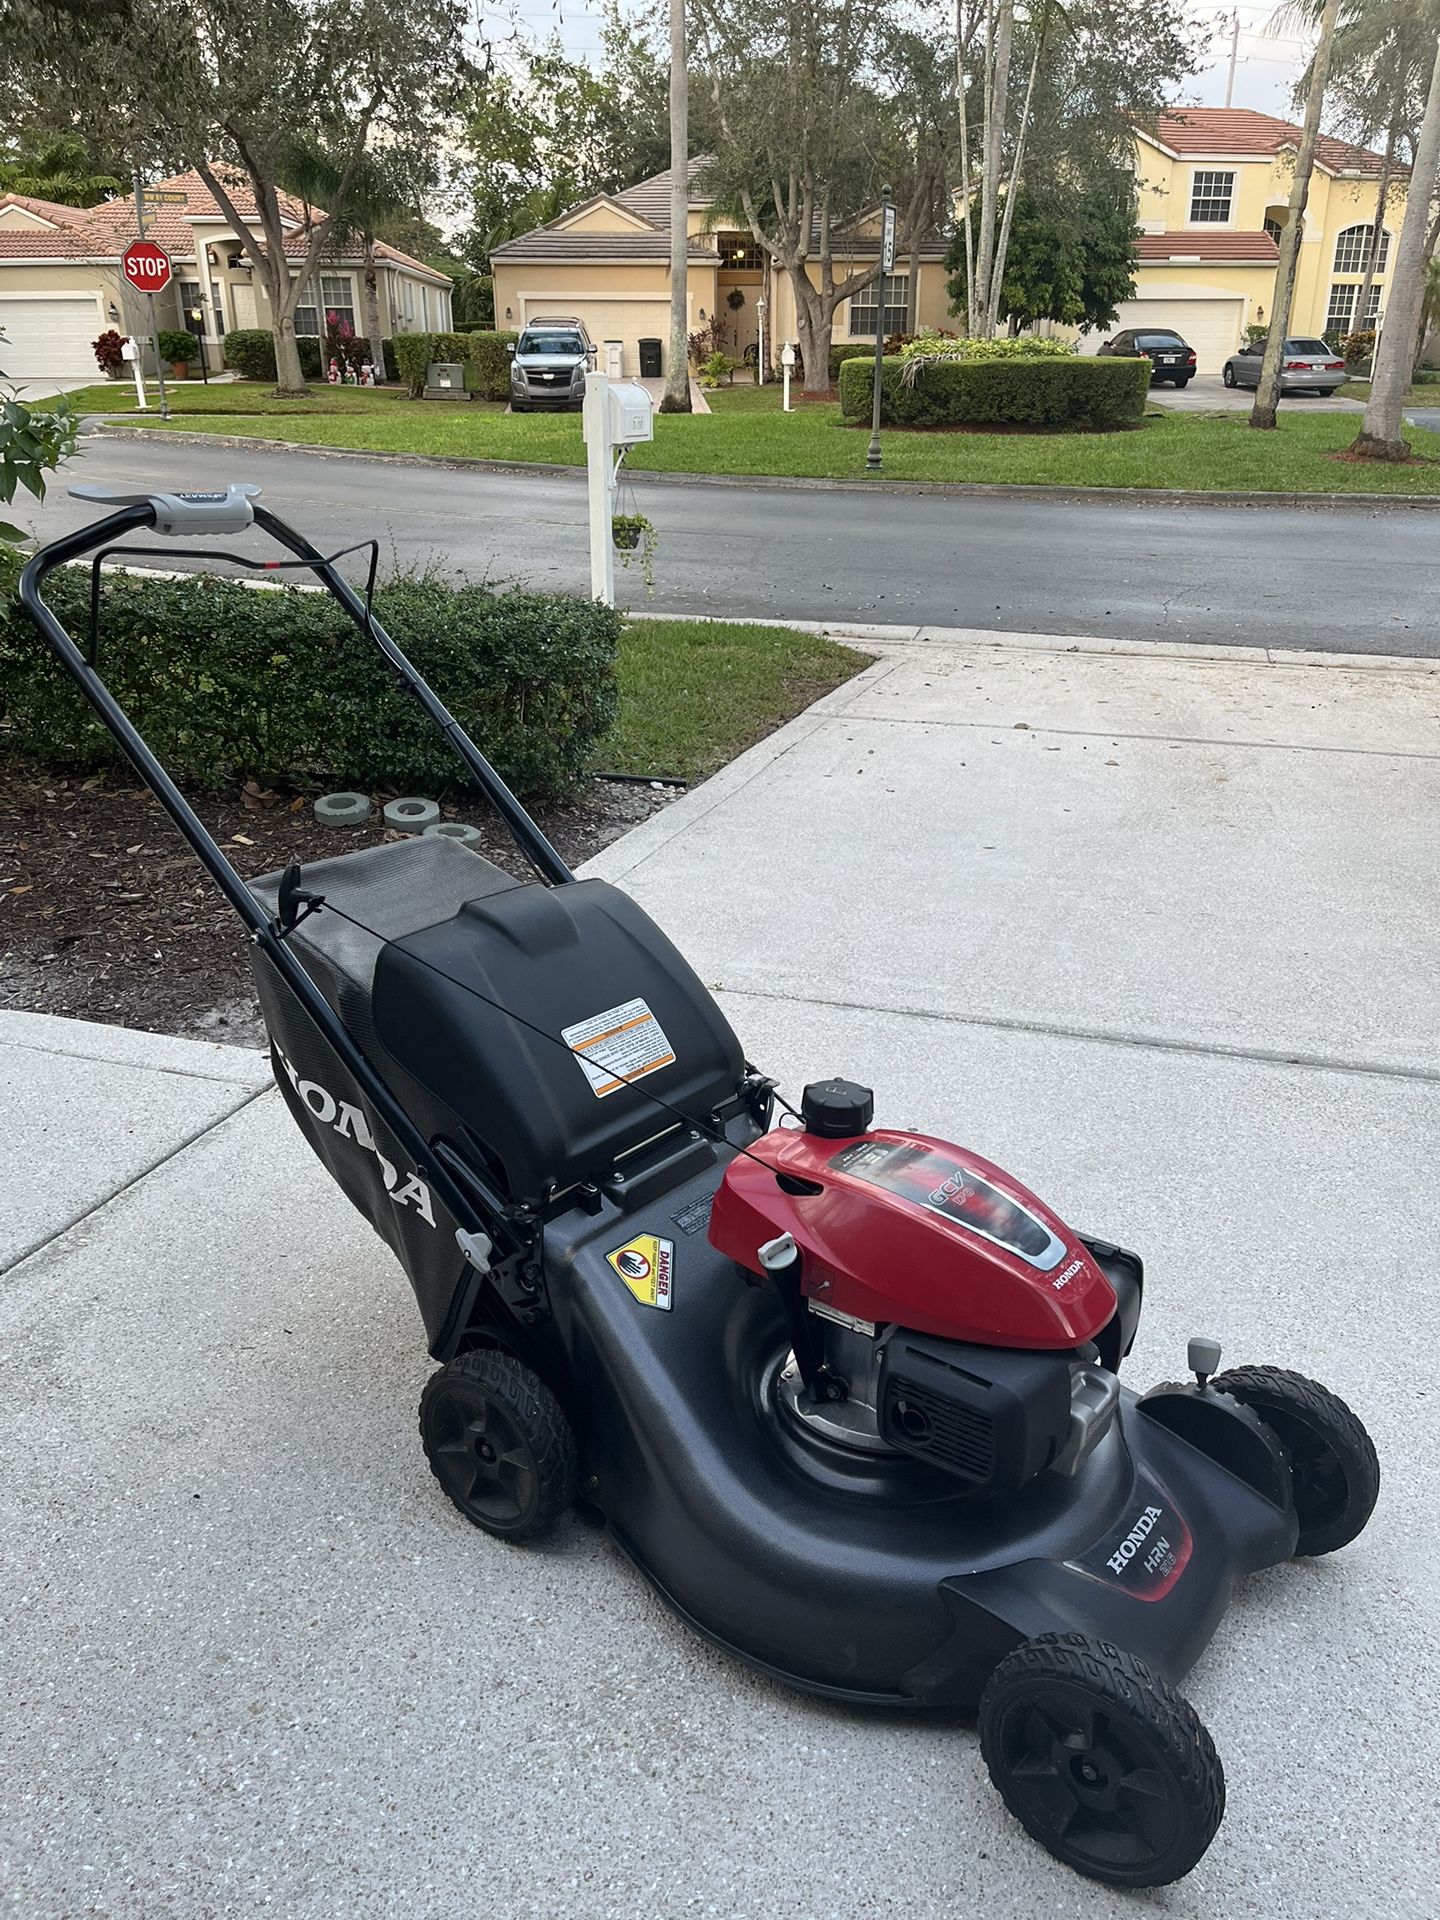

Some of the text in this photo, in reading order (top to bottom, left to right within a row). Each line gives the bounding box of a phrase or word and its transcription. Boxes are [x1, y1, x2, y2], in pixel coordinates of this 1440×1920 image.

[164, 193, 185, 203] COURT
[127, 257, 167, 277] STOP
[928, 1171, 964, 1205] GCV
[952, 1187, 975, 1206] 170
[658, 1250, 670, 1296] DANGER
[1052, 1260, 1084, 1290] HONDA
[1106, 1505, 1163, 1575] HONDA
[1143, 1536, 1171, 1574] HRN
[1159, 1552, 1177, 1577] 216
